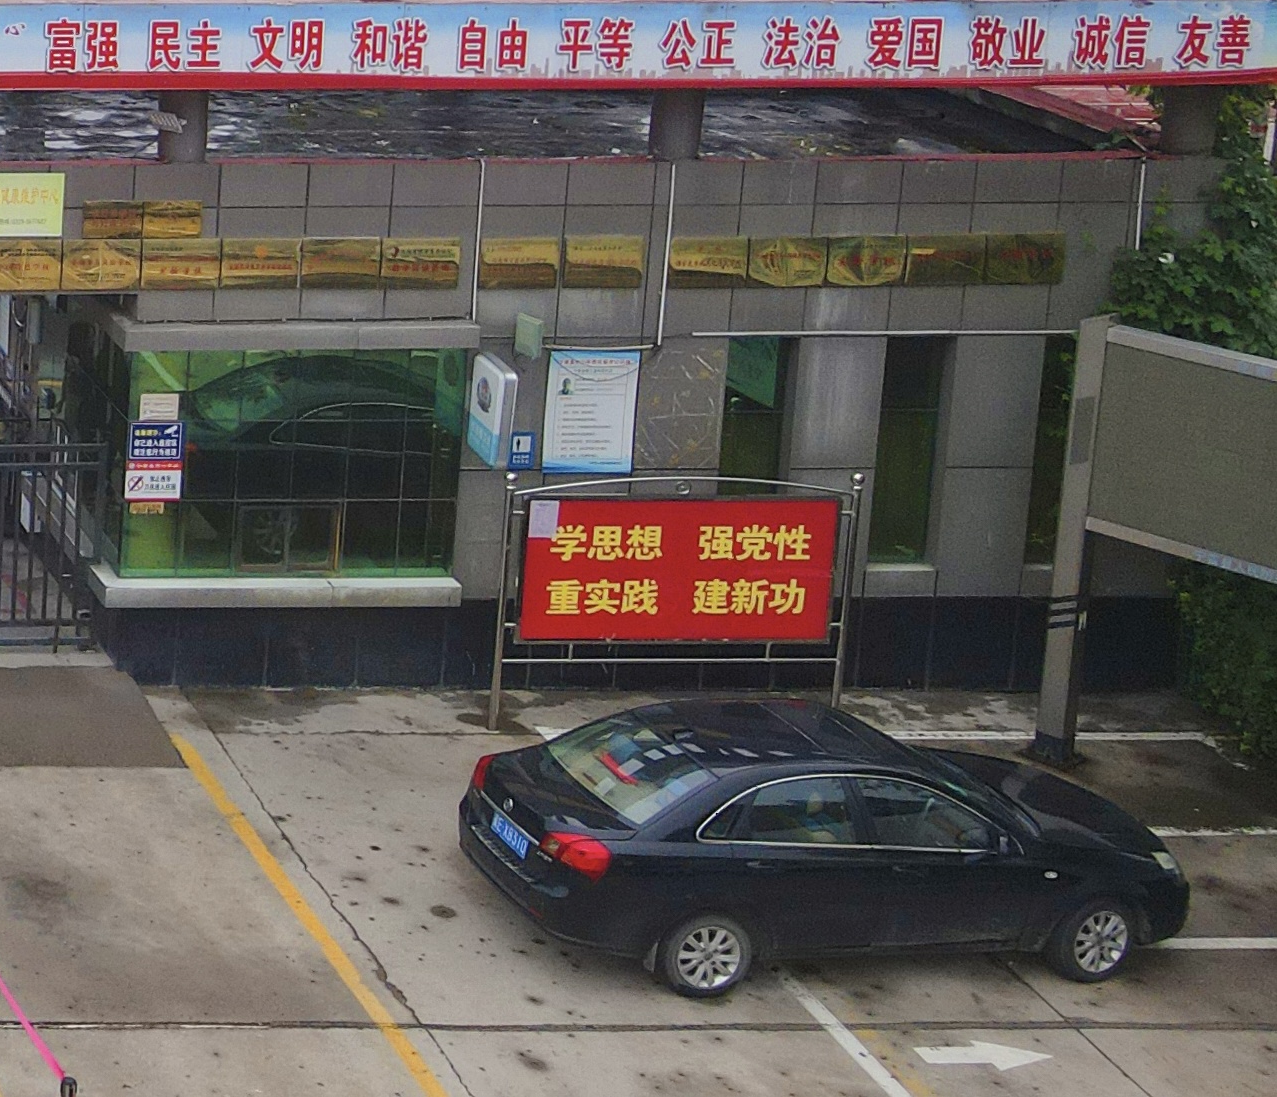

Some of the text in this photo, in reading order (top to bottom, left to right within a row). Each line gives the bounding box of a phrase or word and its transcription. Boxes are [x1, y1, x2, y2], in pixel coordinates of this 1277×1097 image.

[44, 18, 120, 72] 富强
[147, 19, 223, 72] 民主
[250, 18, 325, 71] 文明
[351, 18, 429, 72] 和谐
[455, 18, 529, 72] 自由
[557, 17, 635, 72] 平等
[659, 18, 737, 71] 公正
[762, 17, 843, 69] 法治
[866, 16, 944, 70] 爱国
[969, 15, 1047, 70] 敬业
[1074, 14, 1152, 68] 诚信
[1177, 13, 1252, 67] 友善
[550, 524, 812, 562] 学思想 强党性
[545, 579, 806, 615] 重实践 建新功
